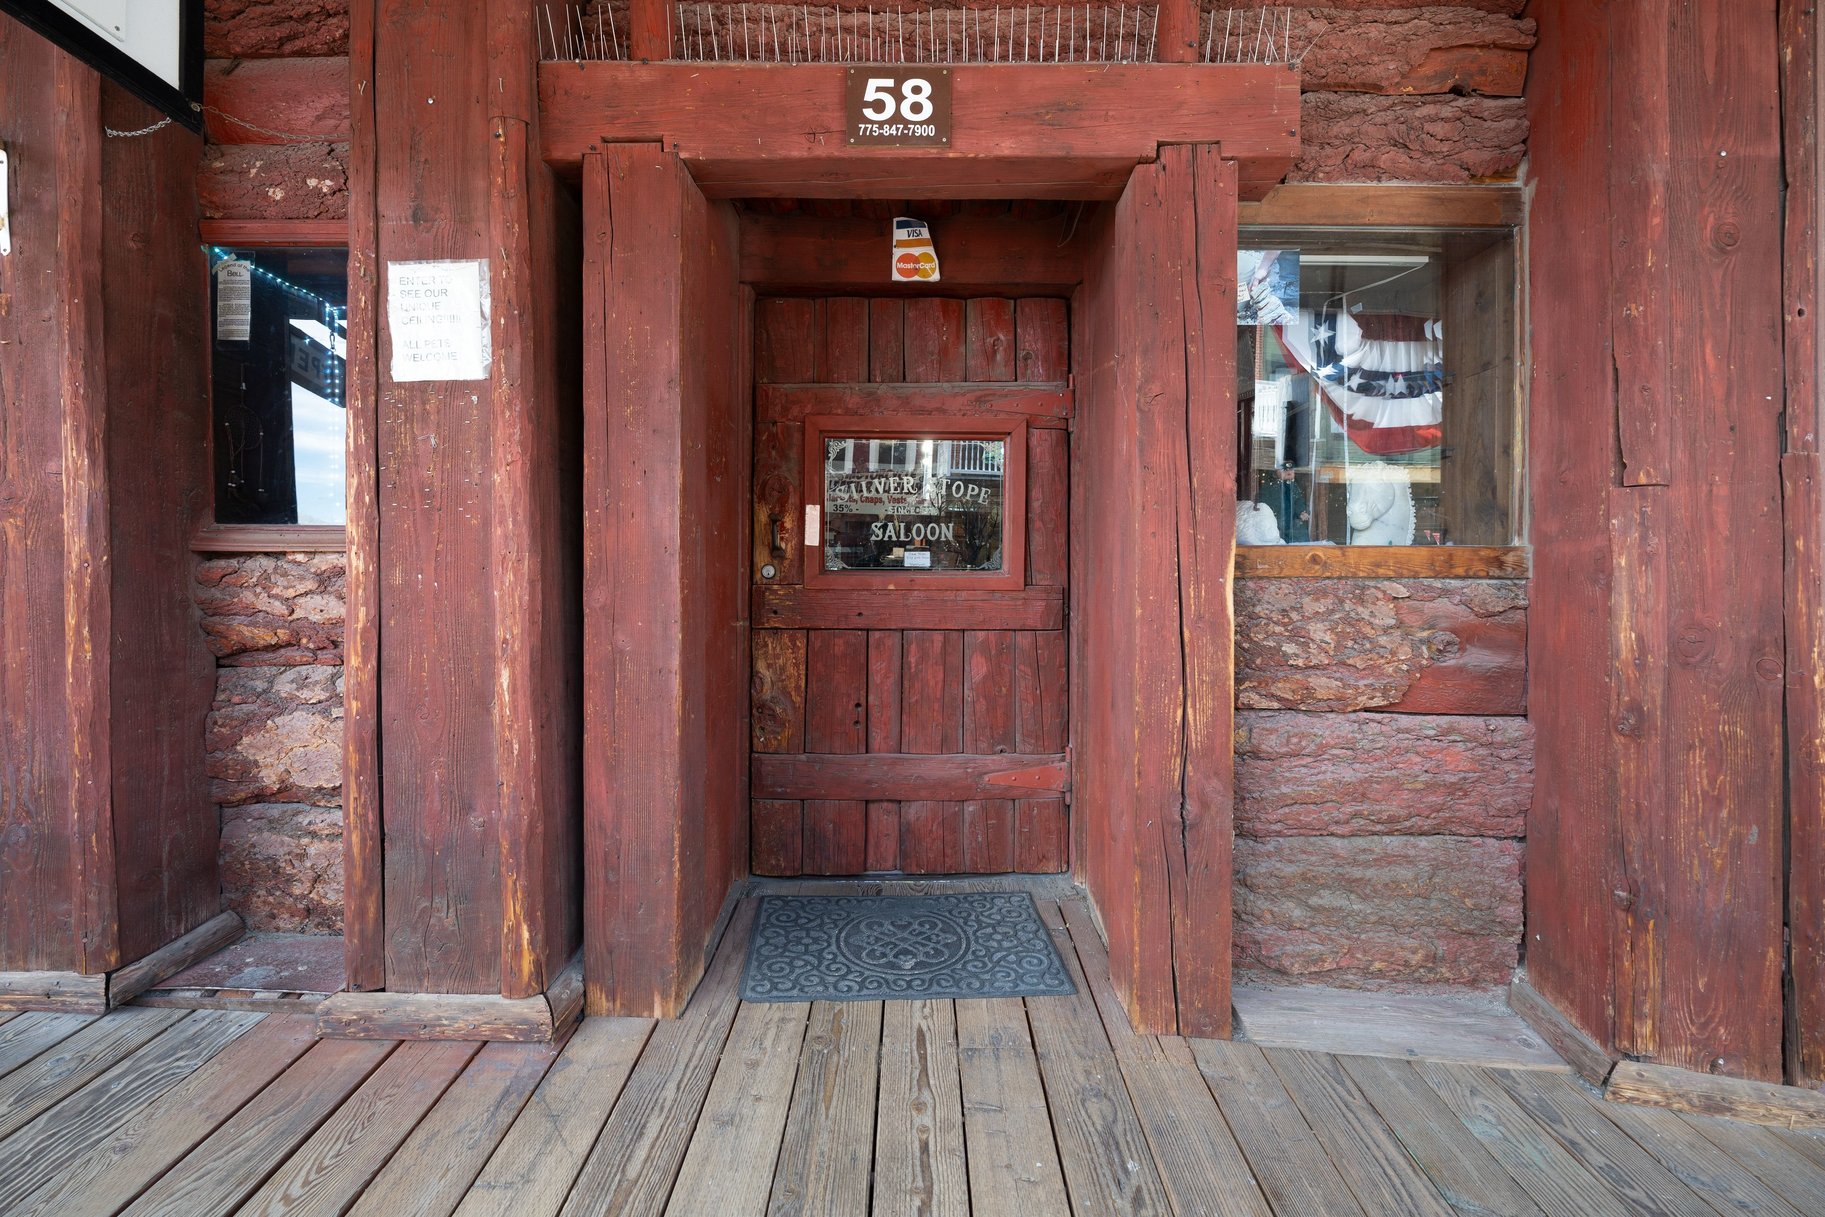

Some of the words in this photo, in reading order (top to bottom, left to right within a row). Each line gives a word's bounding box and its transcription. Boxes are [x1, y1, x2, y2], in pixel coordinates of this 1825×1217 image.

[862, 78, 934, 121] 58
[858, 124, 936, 137] 775-847-7900
[907, 229, 923, 238] VISA
[400, 289, 421, 299] SEE
[424, 288, 449, 298] OUR
[836, 476, 918, 502] SILVER
[833, 504, 853, 512] 35%
[870, 523, 954, 541] SALOON
